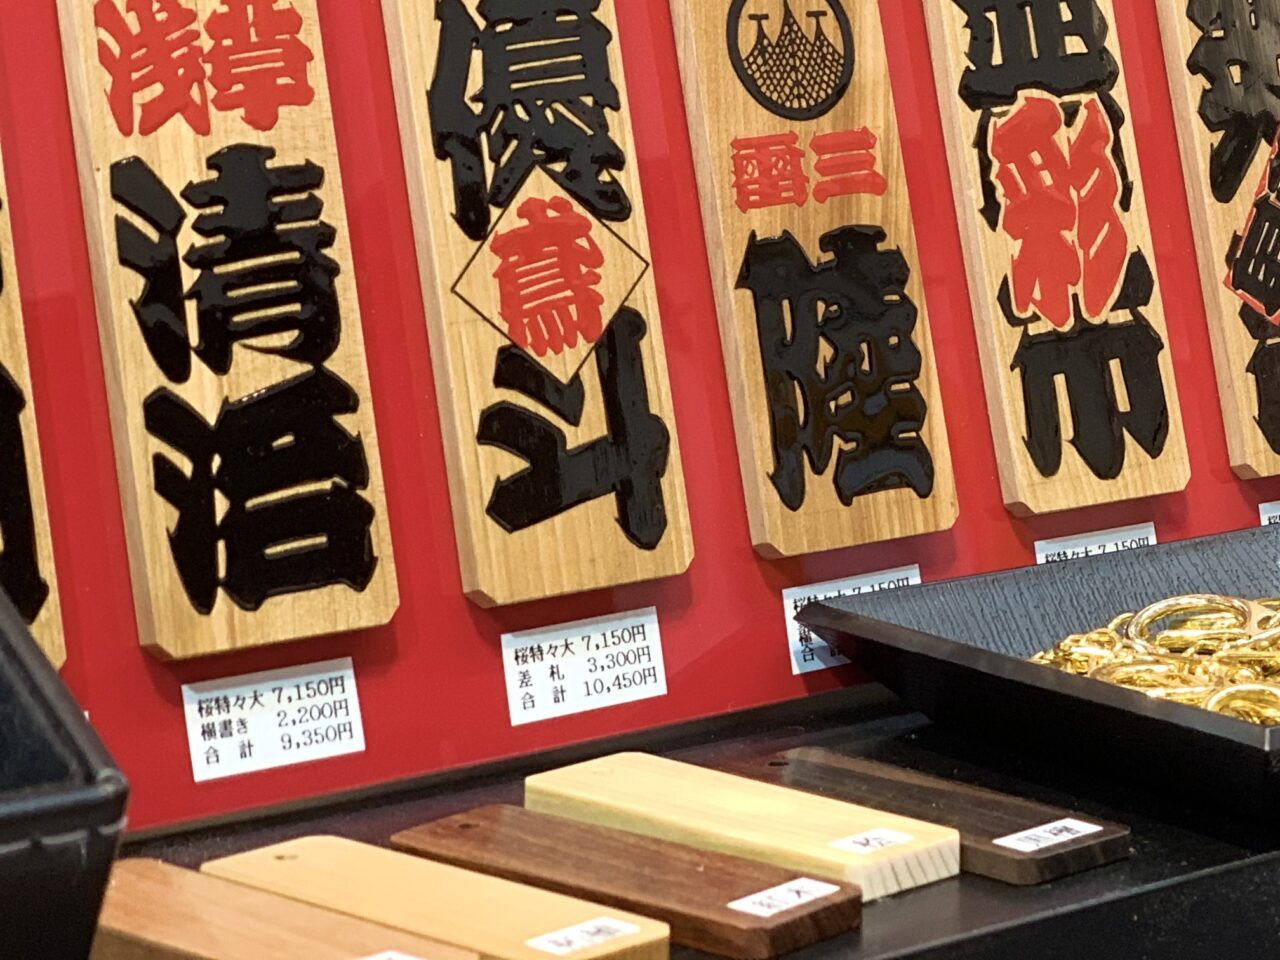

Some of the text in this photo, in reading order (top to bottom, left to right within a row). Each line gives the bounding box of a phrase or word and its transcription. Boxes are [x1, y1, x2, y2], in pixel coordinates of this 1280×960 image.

[514, 623, 647, 667] 桜特々大 7,150円
[587, 645, 652, 674] 3,300円
[197, 675, 346, 719] 桜特々大 7,150円
[583, 666, 658, 698] 10,450円
[200, 698, 351, 742] 横書き 2,200円
[281, 721, 354, 751] 9,350円
